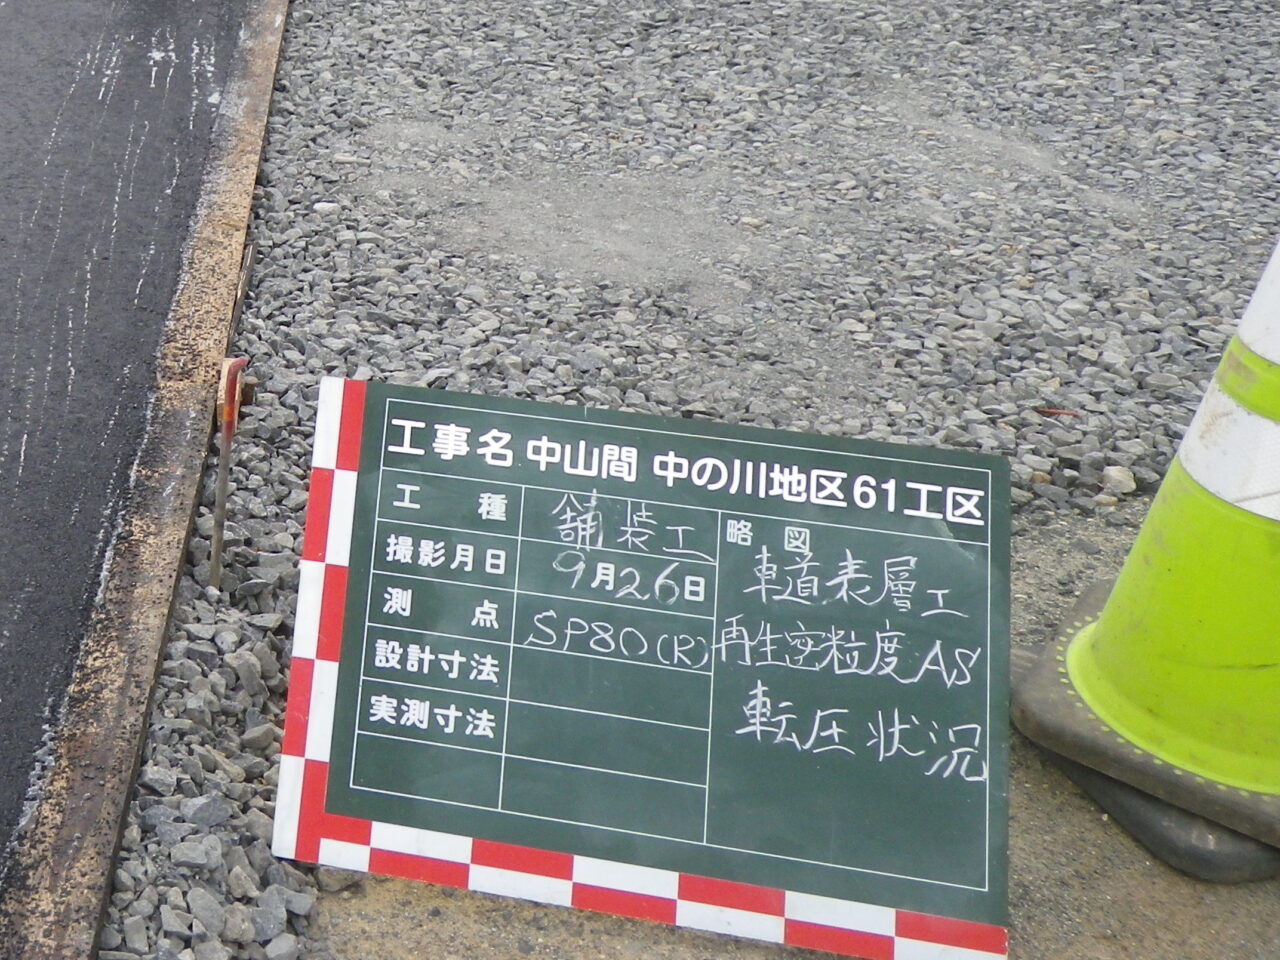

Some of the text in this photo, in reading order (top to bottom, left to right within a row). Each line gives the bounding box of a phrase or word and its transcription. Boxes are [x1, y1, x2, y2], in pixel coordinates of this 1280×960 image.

[387, 418, 986, 527] 工事名 中山間 中の川地区61工区
[385, 533, 507, 575] 撮影月日
[743, 544, 970, 618] 車道表層工
[374, 639, 500, 684] 設計寸法
[369, 694, 497, 739] 実測寸法
[735, 679, 988, 782] 転圧状況
